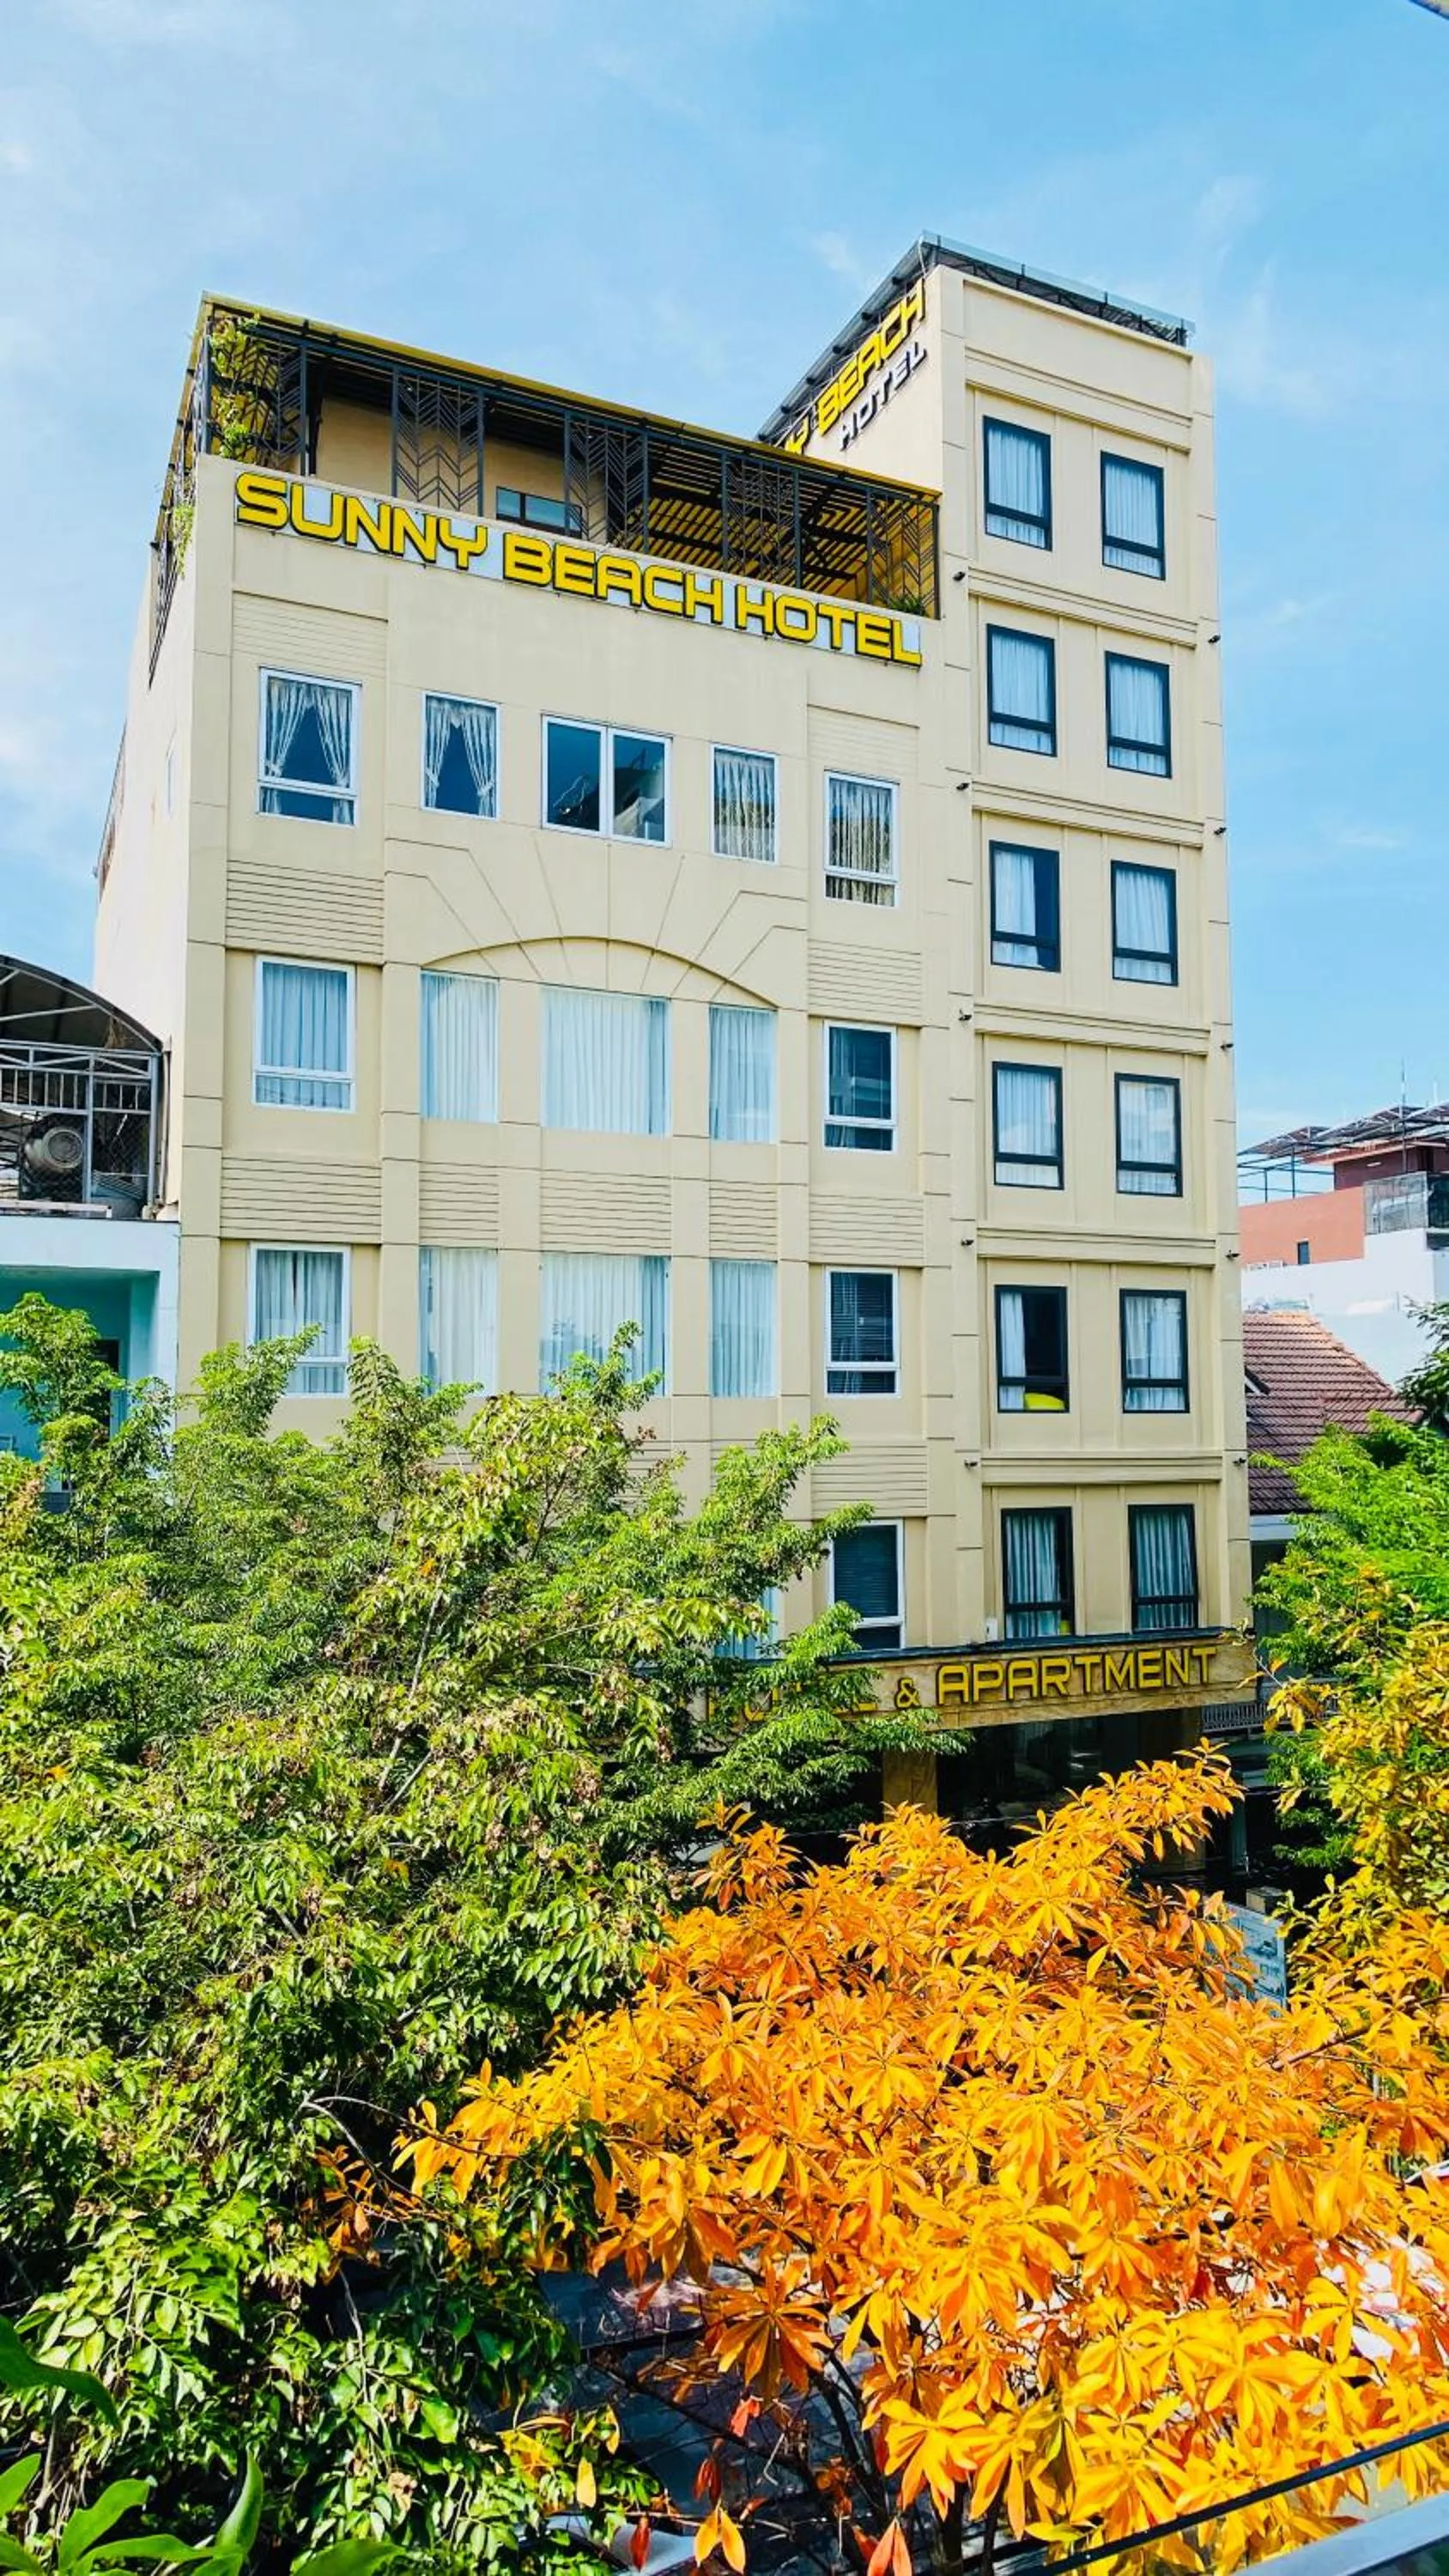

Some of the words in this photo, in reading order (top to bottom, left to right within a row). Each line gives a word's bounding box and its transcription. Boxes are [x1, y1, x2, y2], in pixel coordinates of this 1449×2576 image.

[816, 279, 925, 435] BEACH
[841, 343, 926, 450] HOTEL
[236, 472, 487, 569] SUNNY
[502, 532, 723, 623] BEACH
[737, 584, 922, 666] HOTEL
[895, 1677, 919, 1709] &
[937, 1646, 1217, 1704] APARTMENT
